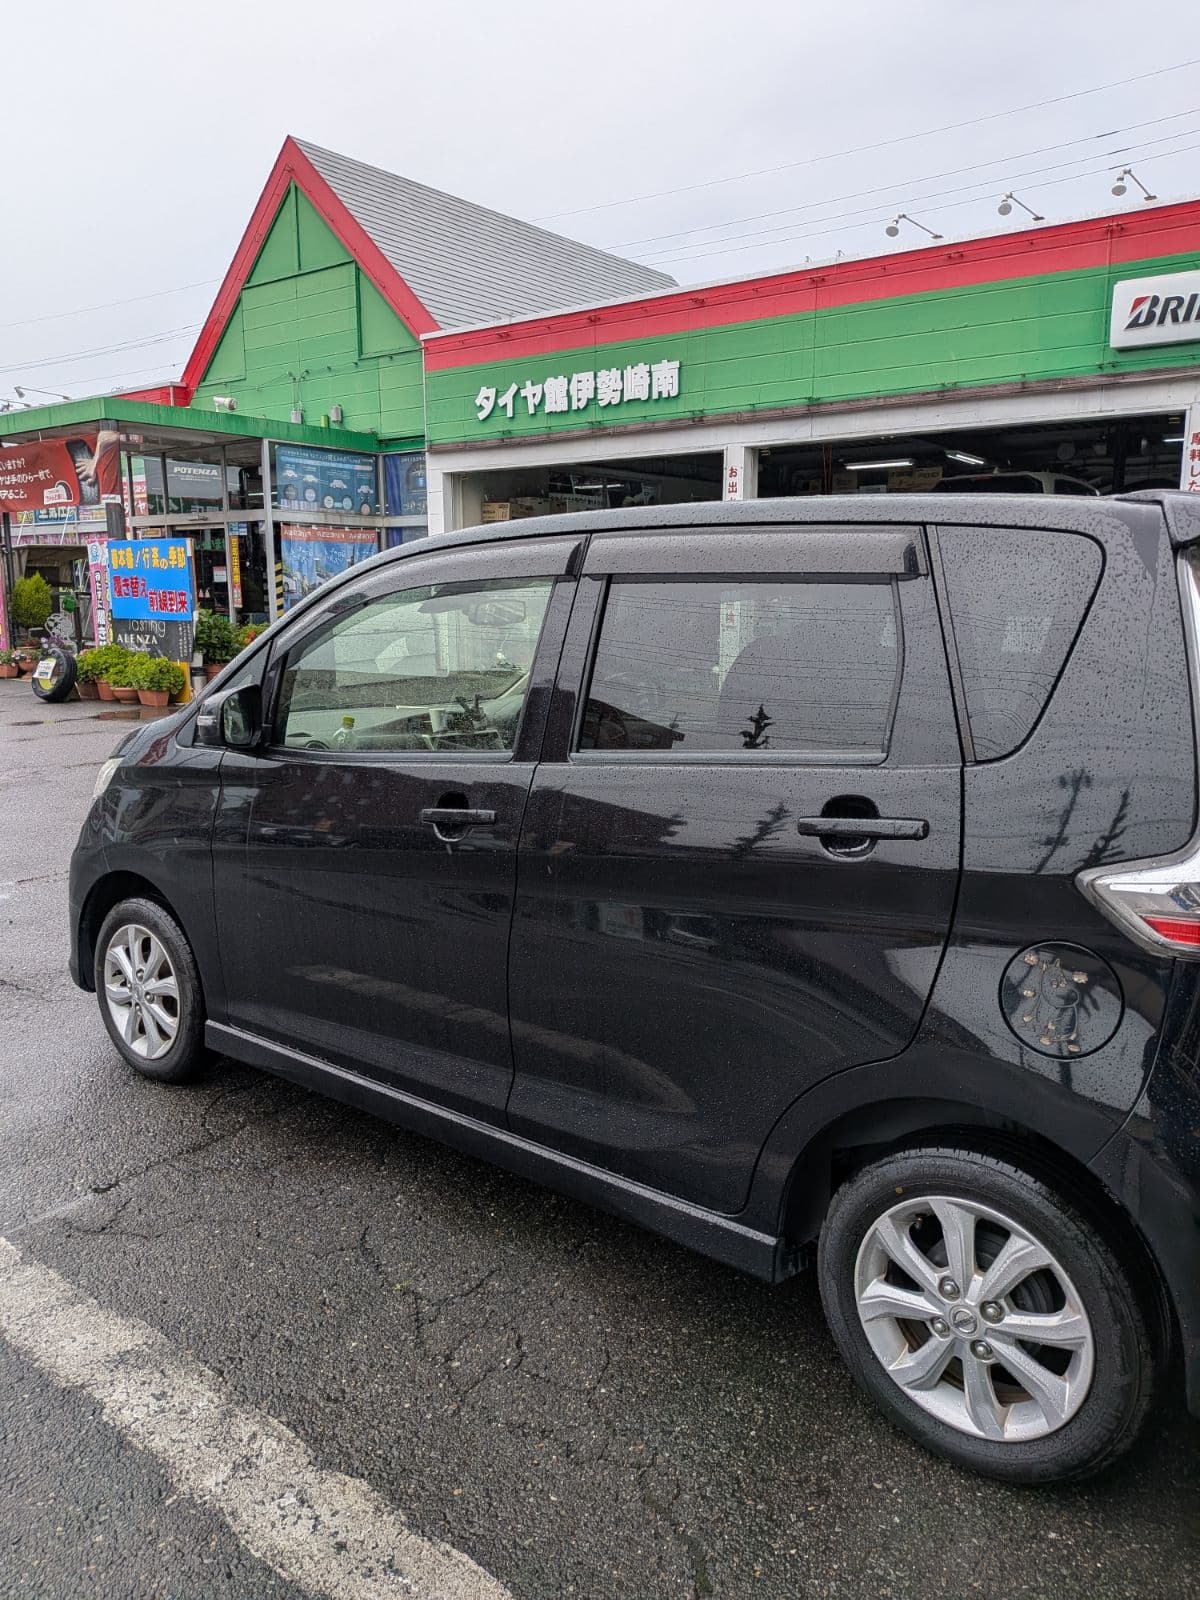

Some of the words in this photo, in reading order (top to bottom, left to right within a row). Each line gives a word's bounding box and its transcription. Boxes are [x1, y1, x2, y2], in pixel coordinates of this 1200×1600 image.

[1124, 293, 1200, 329] BRI
[474, 359, 680, 421] タイヤ館伊勢崎南
[173, 466, 218, 476] POTENZA
[116, 633, 158, 645] ALENZA
